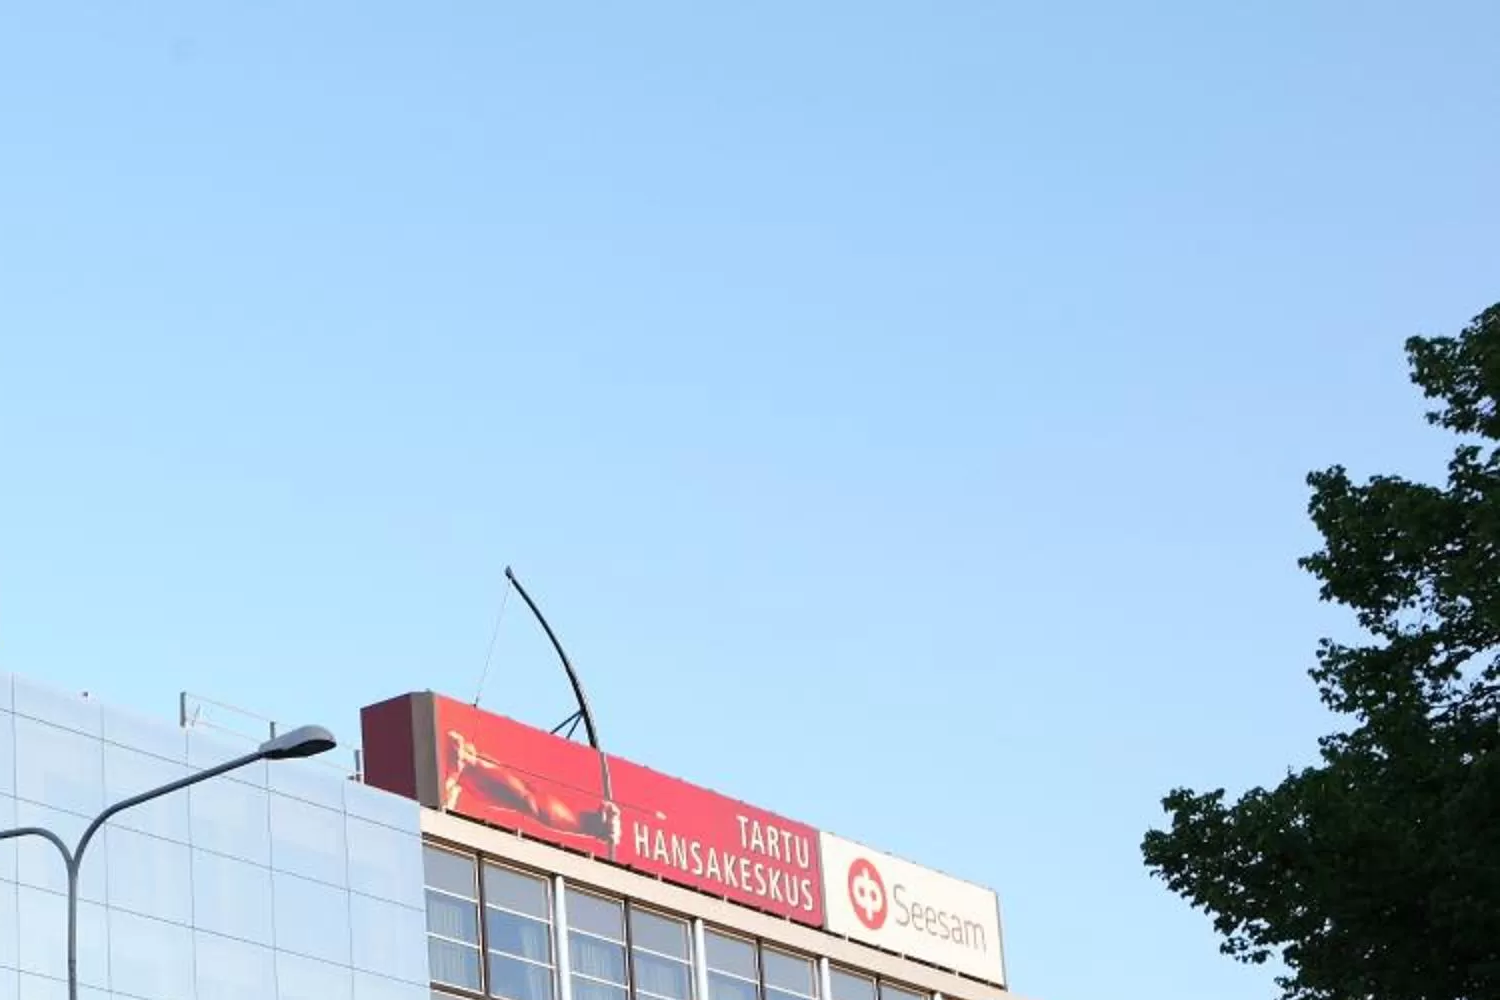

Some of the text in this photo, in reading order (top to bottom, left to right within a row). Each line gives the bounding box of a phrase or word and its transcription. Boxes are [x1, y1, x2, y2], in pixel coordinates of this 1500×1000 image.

[632, 821, 815, 911] HANSAKESKUS
[736, 813, 810, 869] TARTU
[892, 883, 988, 952] Seesam
